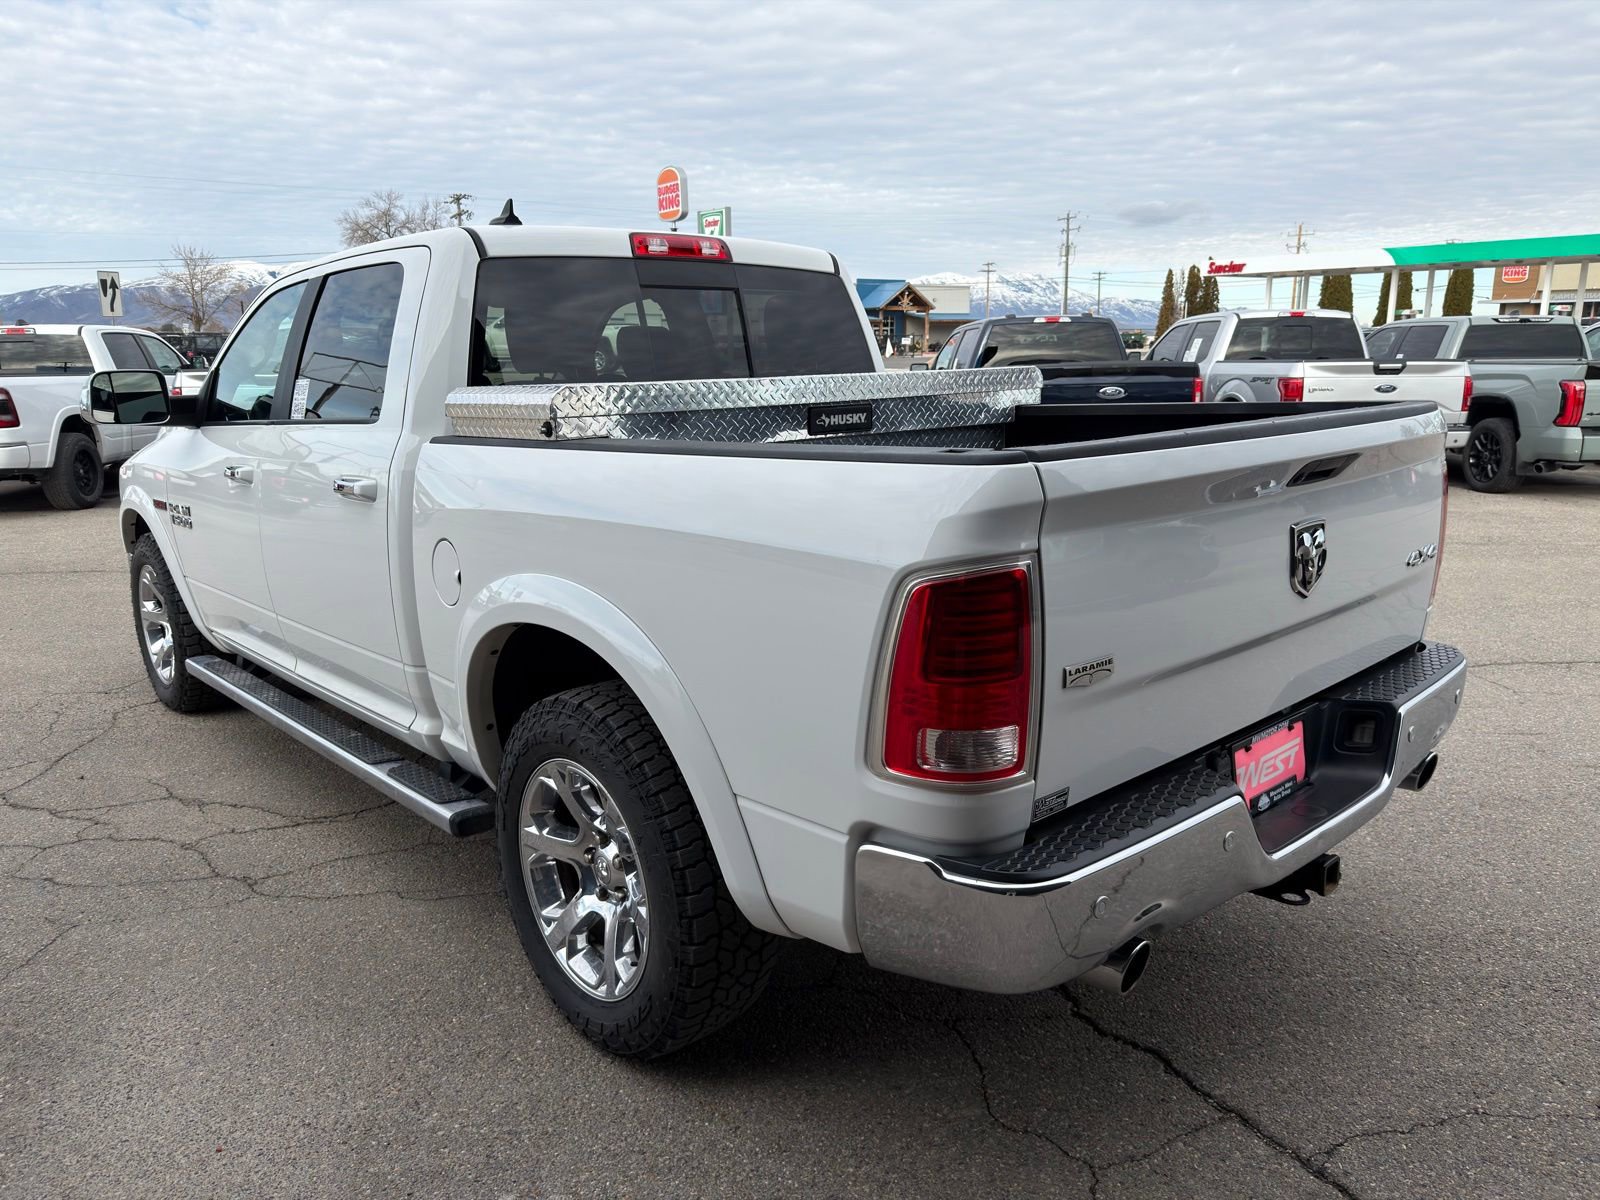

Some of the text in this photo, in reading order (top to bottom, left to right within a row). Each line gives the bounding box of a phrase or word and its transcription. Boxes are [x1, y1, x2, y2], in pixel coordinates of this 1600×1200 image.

[657, 183, 680, 196] BURGER
[658, 193, 681, 211] KING
[1207, 260, 1246, 274] Sinclair
[1503, 269, 1527, 277] KING
[830, 412, 867, 426] HUSKY
[1068, 657, 1113, 677] LARAMIE
[1236, 737, 1301, 793] WEST
